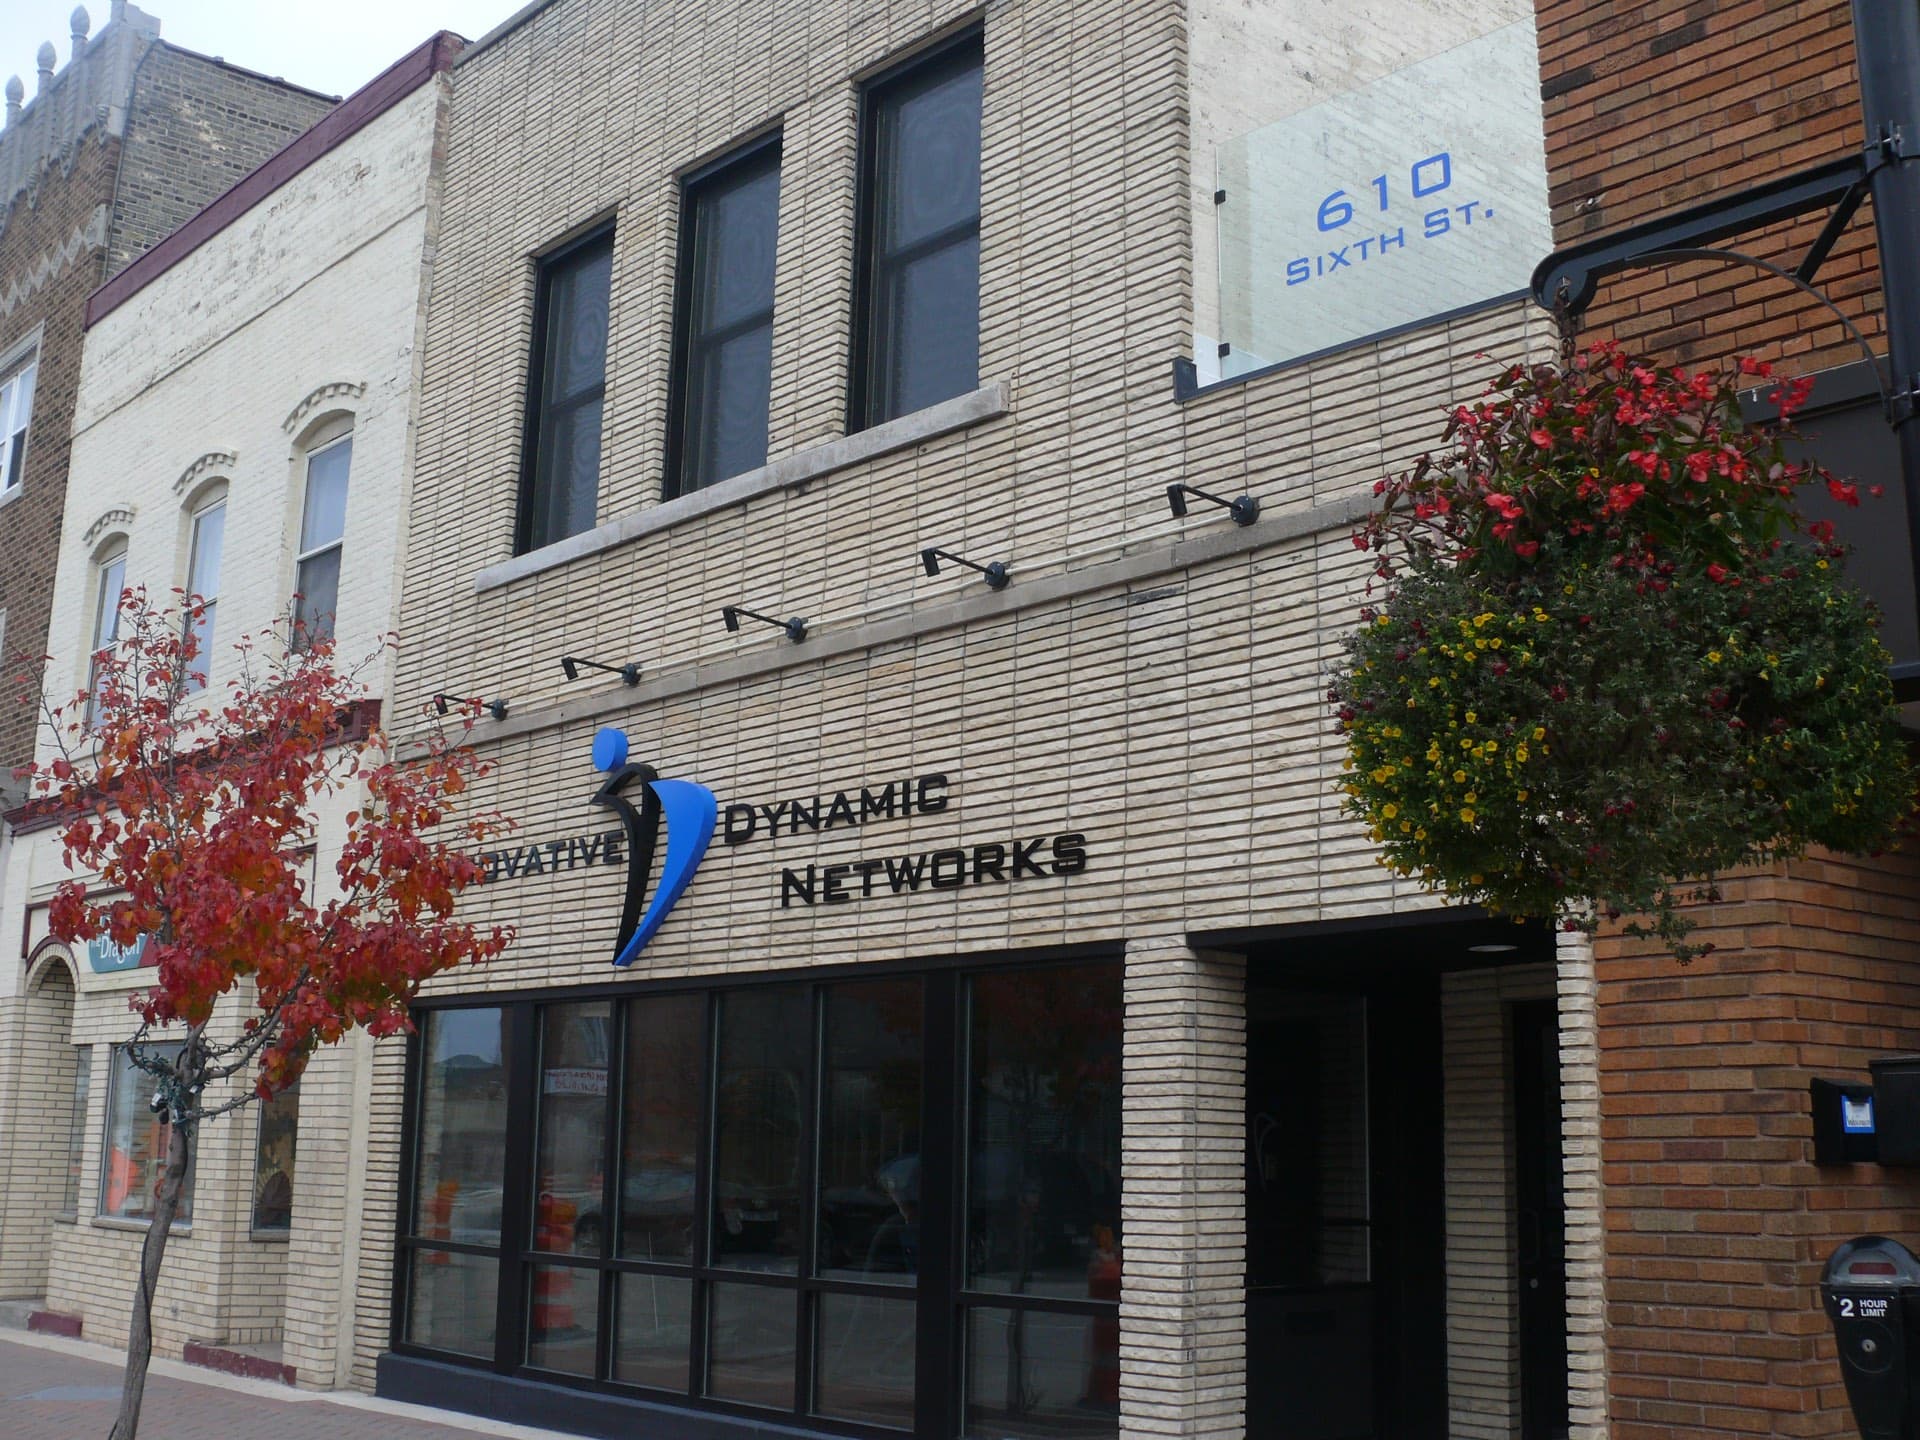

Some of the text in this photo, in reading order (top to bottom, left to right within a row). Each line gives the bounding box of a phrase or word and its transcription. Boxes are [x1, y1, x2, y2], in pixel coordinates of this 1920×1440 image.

[1317, 152, 1452, 232] 610
[1286, 200, 1494, 286] SIXTH ST.
[472, 774, 948, 884] OVATIVE DYNAMIC
[781, 833, 1087, 908] NETWORKS
[1840, 1298, 1888, 1317] 2 HOUR
[1860, 1308, 1886, 1317] LIMIT
